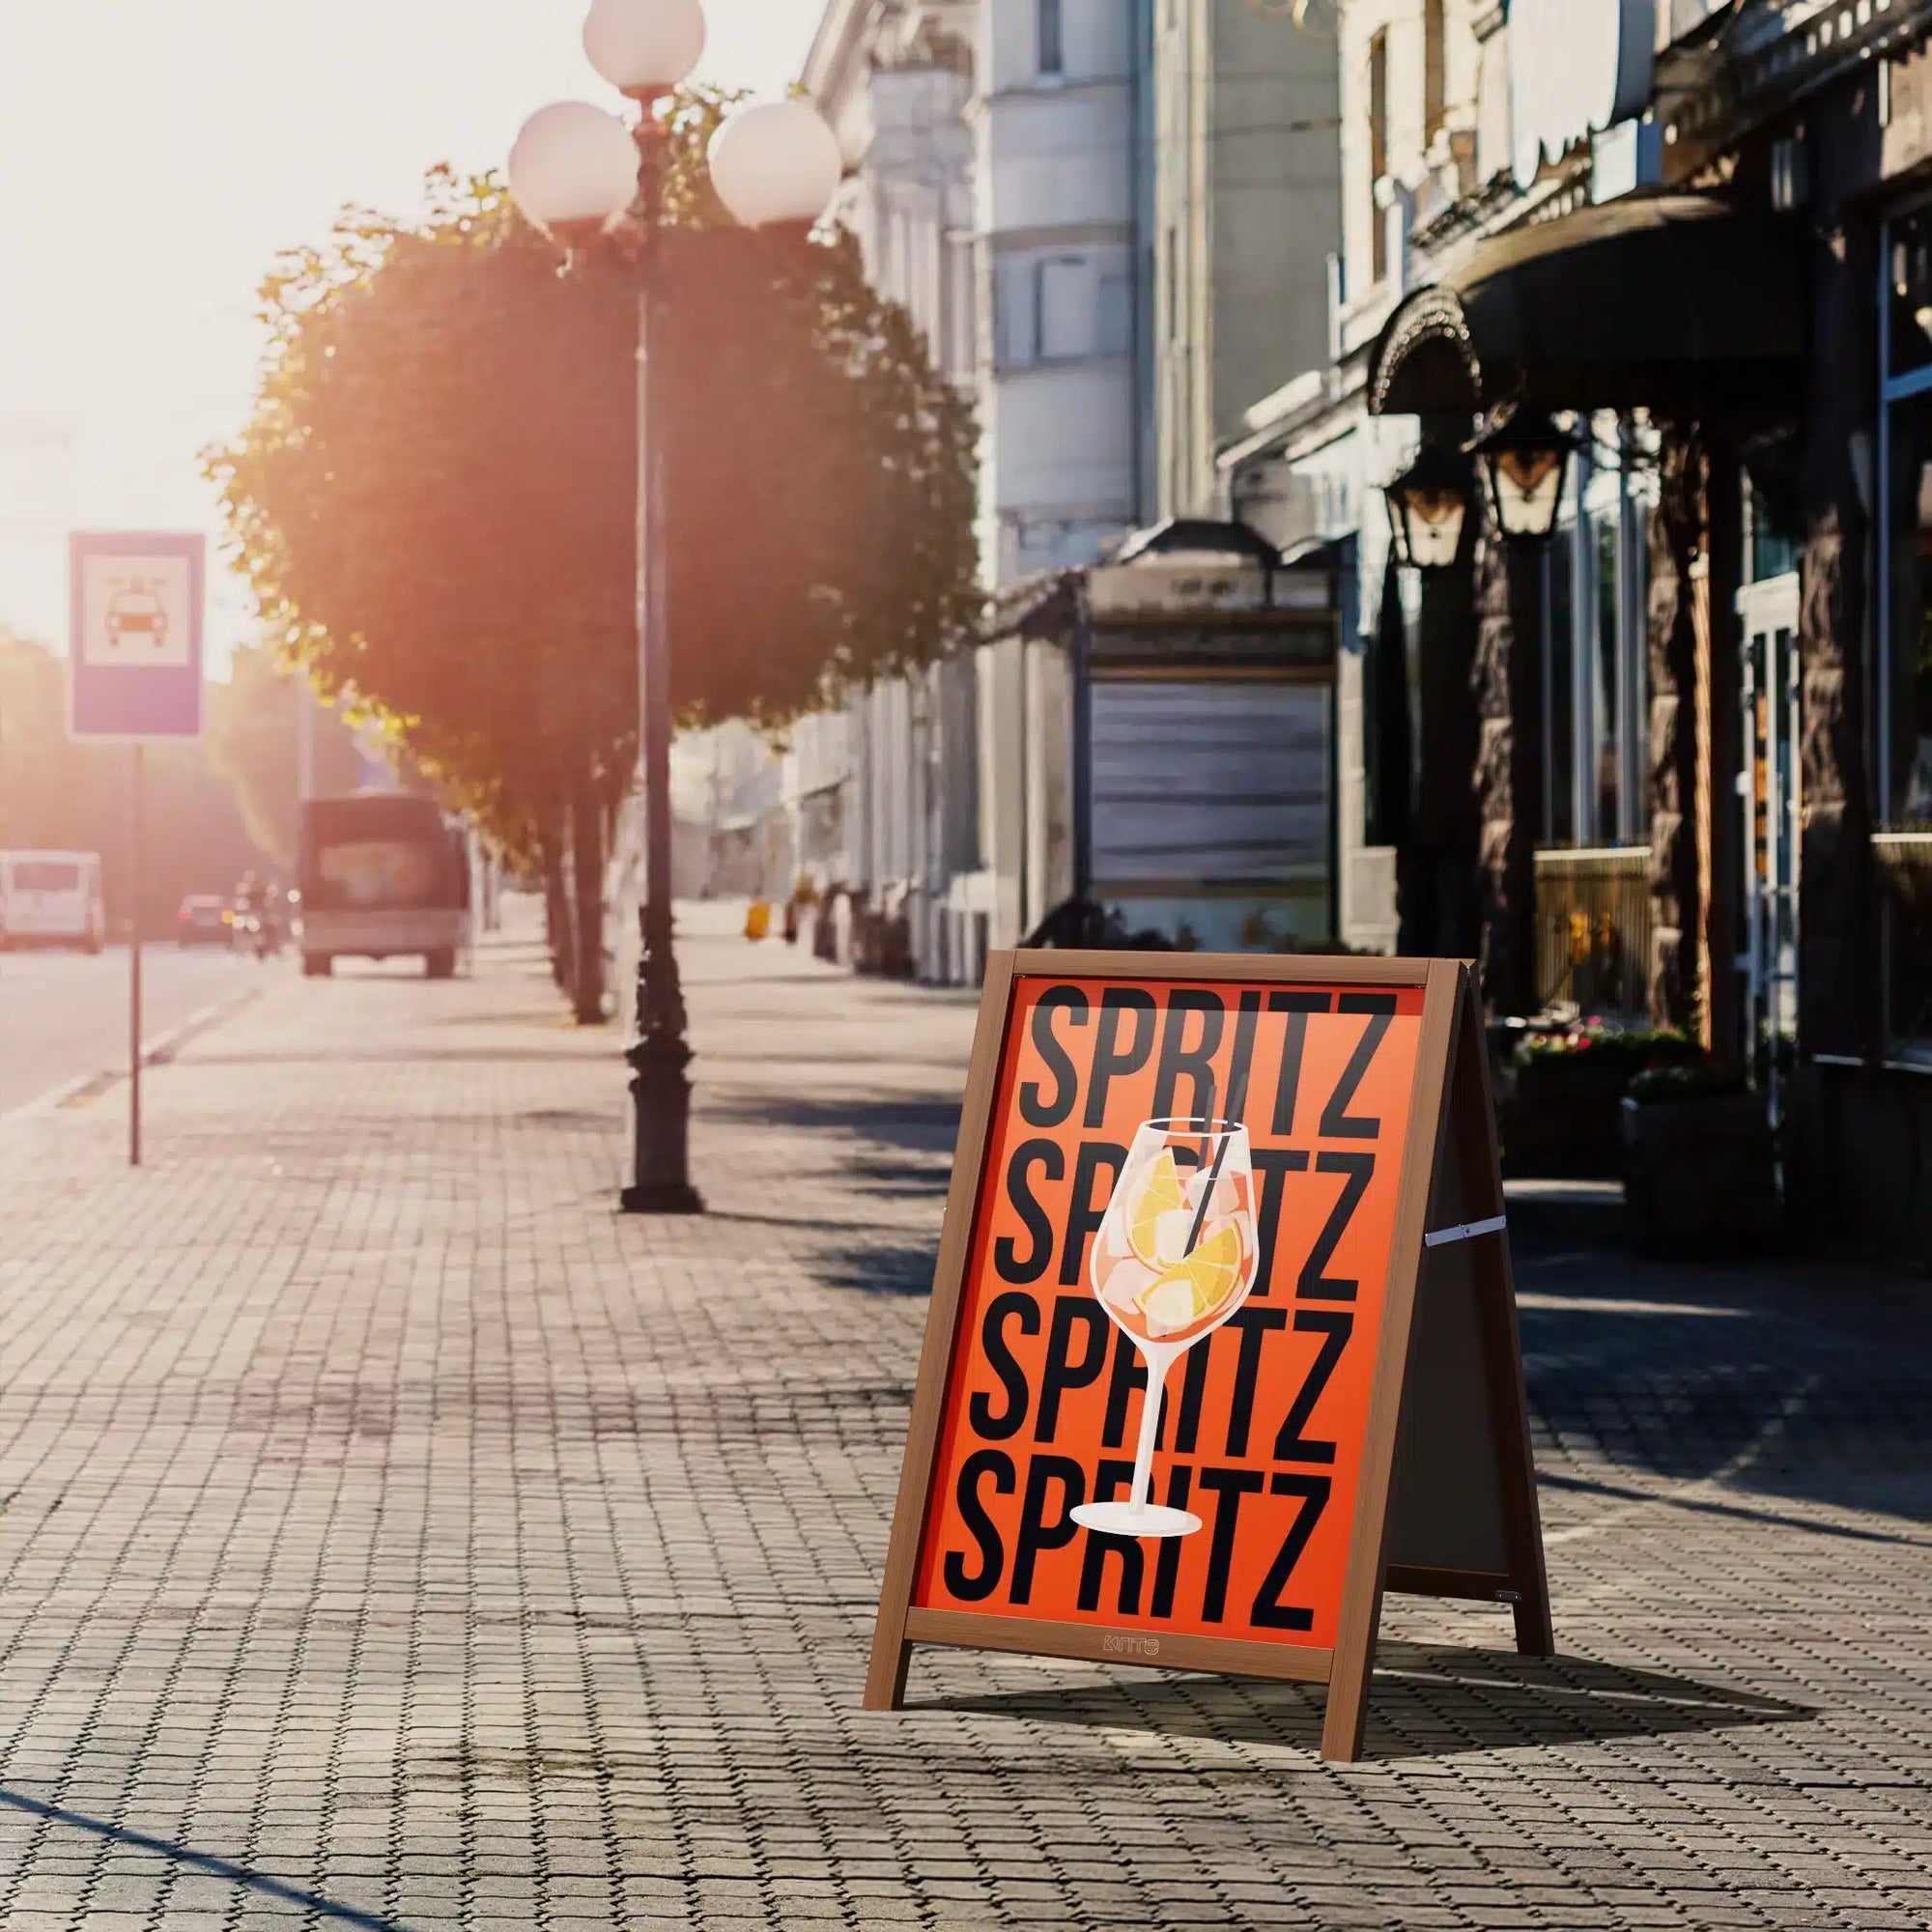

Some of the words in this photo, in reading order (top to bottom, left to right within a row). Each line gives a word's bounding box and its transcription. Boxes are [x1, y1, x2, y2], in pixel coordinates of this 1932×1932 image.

[1019, 985, 1398, 1139] SPRITZ
[994, 1138, 1376, 1301] SPTZ
[944, 1449, 1332, 1632] SPRITZ
